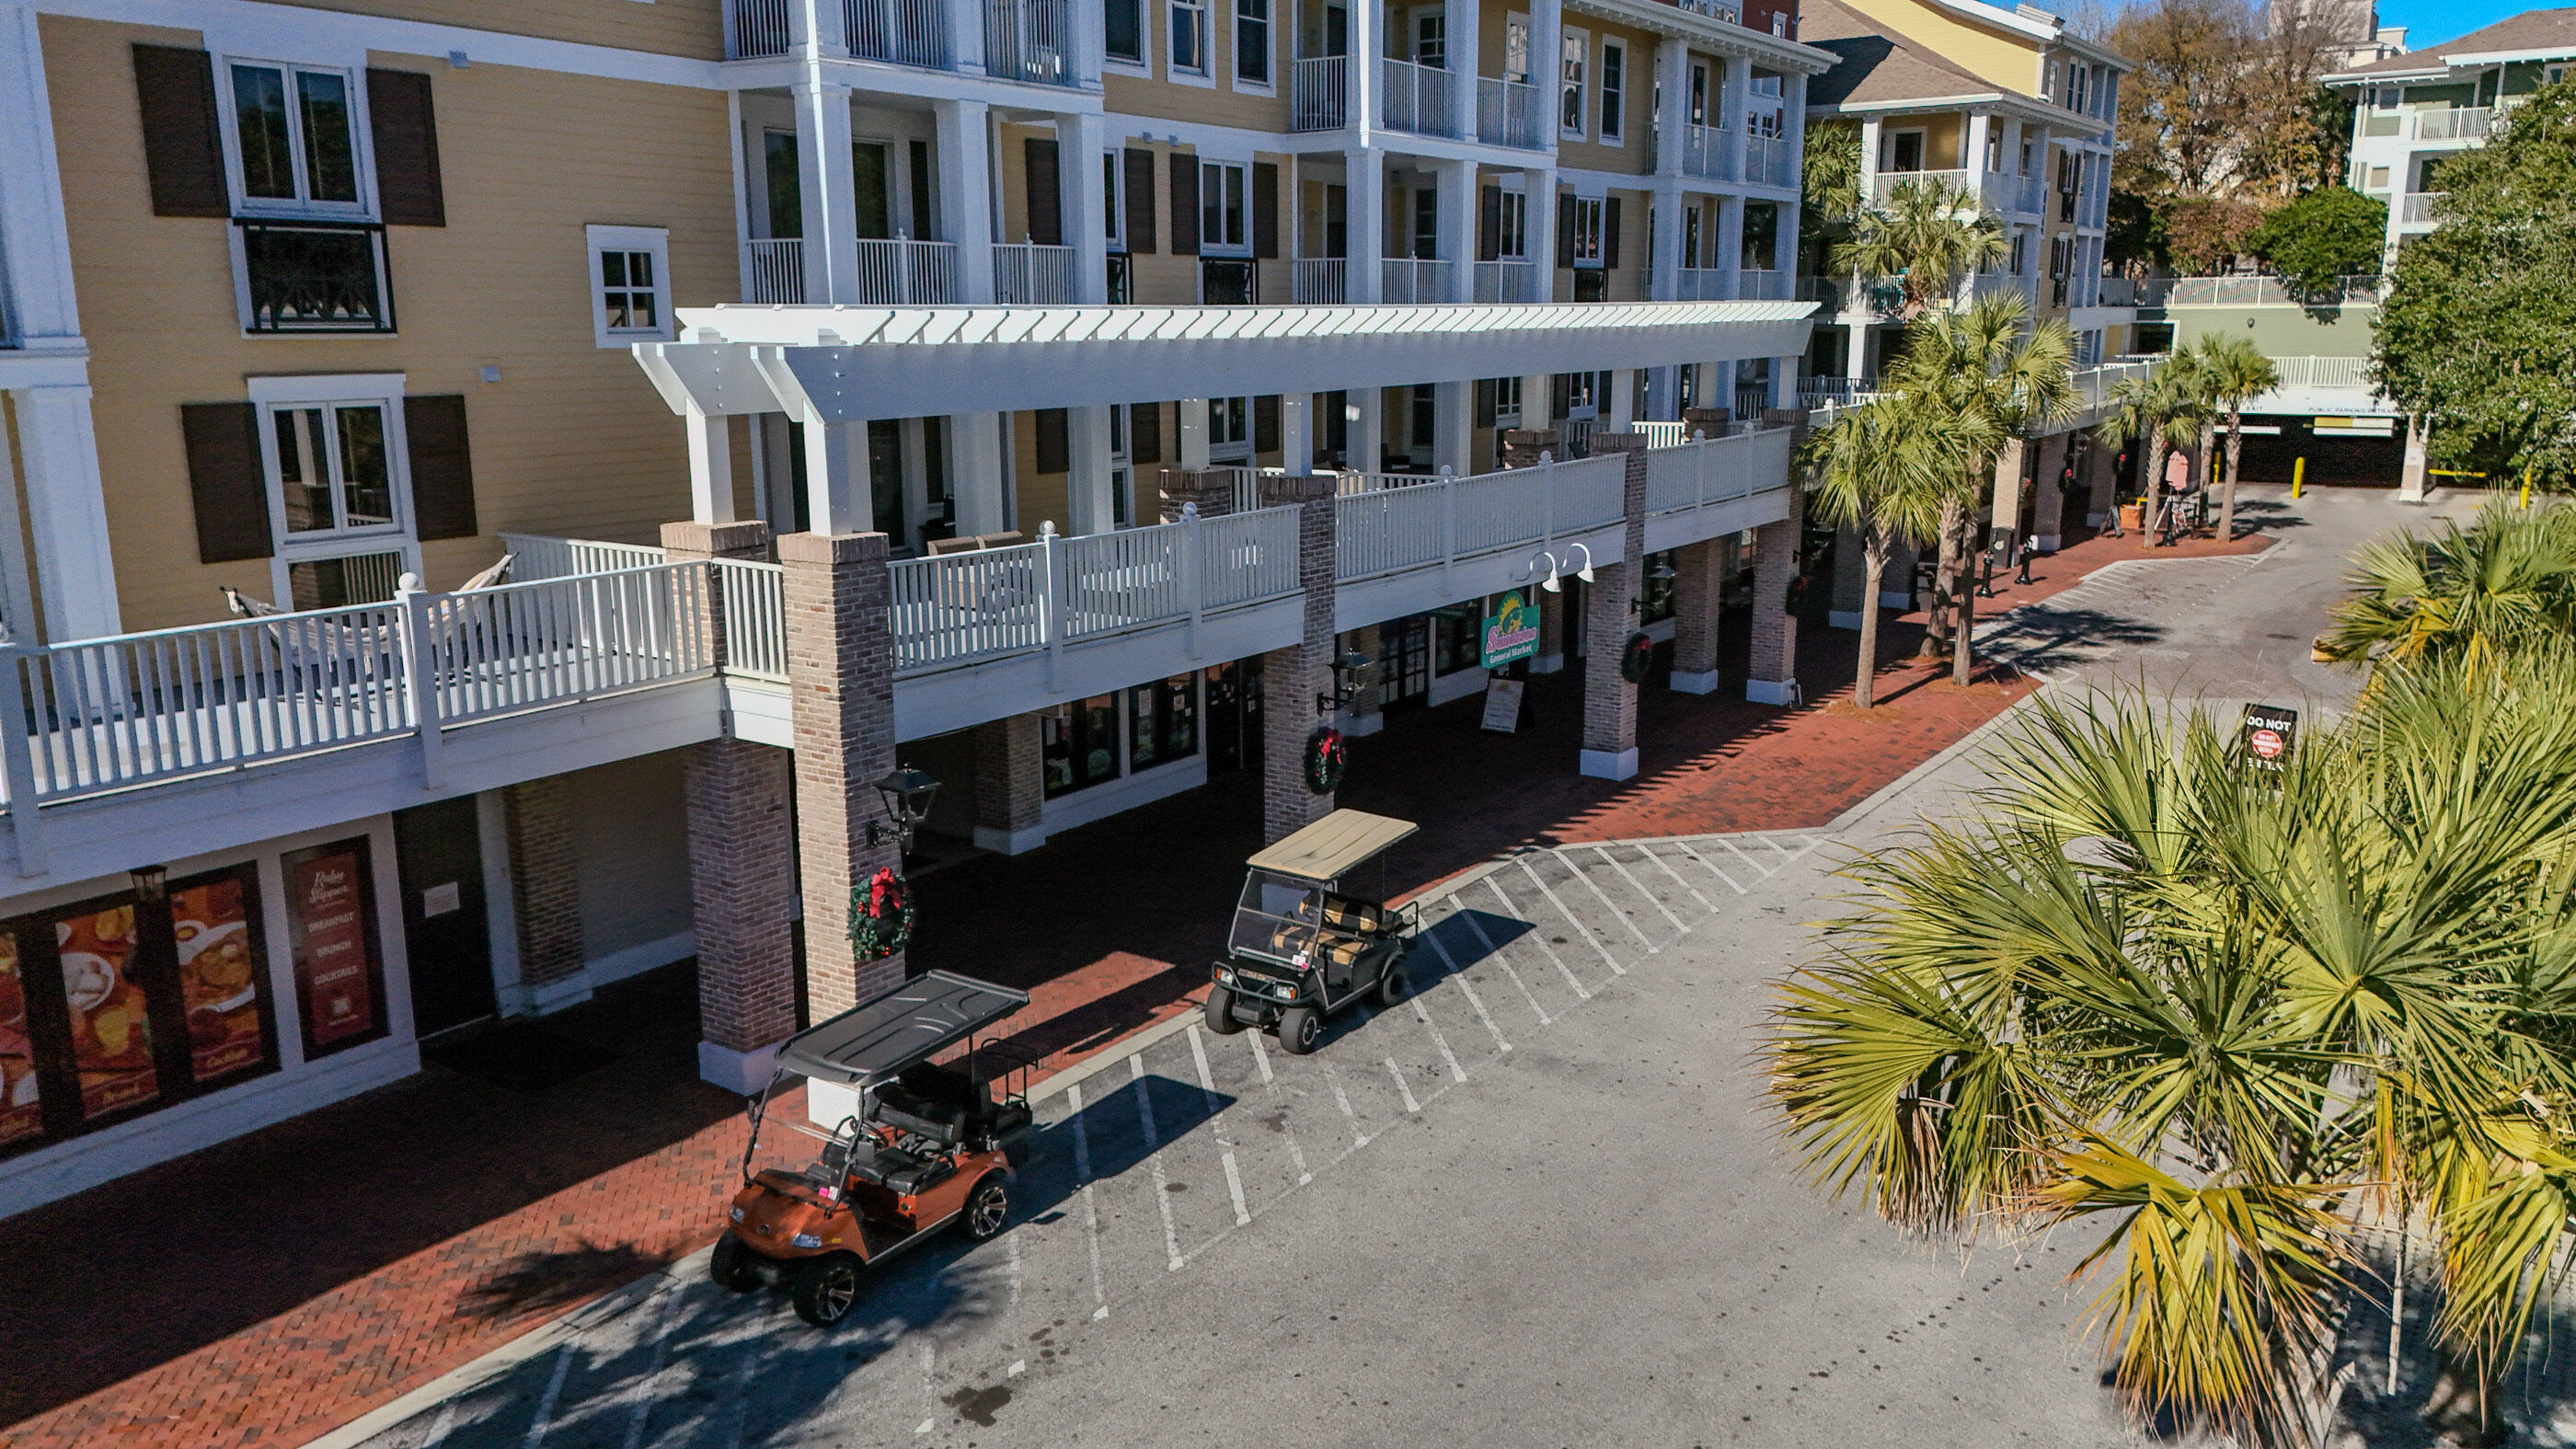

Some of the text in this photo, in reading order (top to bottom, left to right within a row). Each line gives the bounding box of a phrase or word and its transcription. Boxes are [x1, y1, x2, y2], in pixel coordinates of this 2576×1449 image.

[1489, 644, 1532, 663] General Market
[2247, 716, 2291, 731] DO NOT
[316, 940, 352, 958] BRUNCH
[314, 965, 358, 986] COCKTAILS
